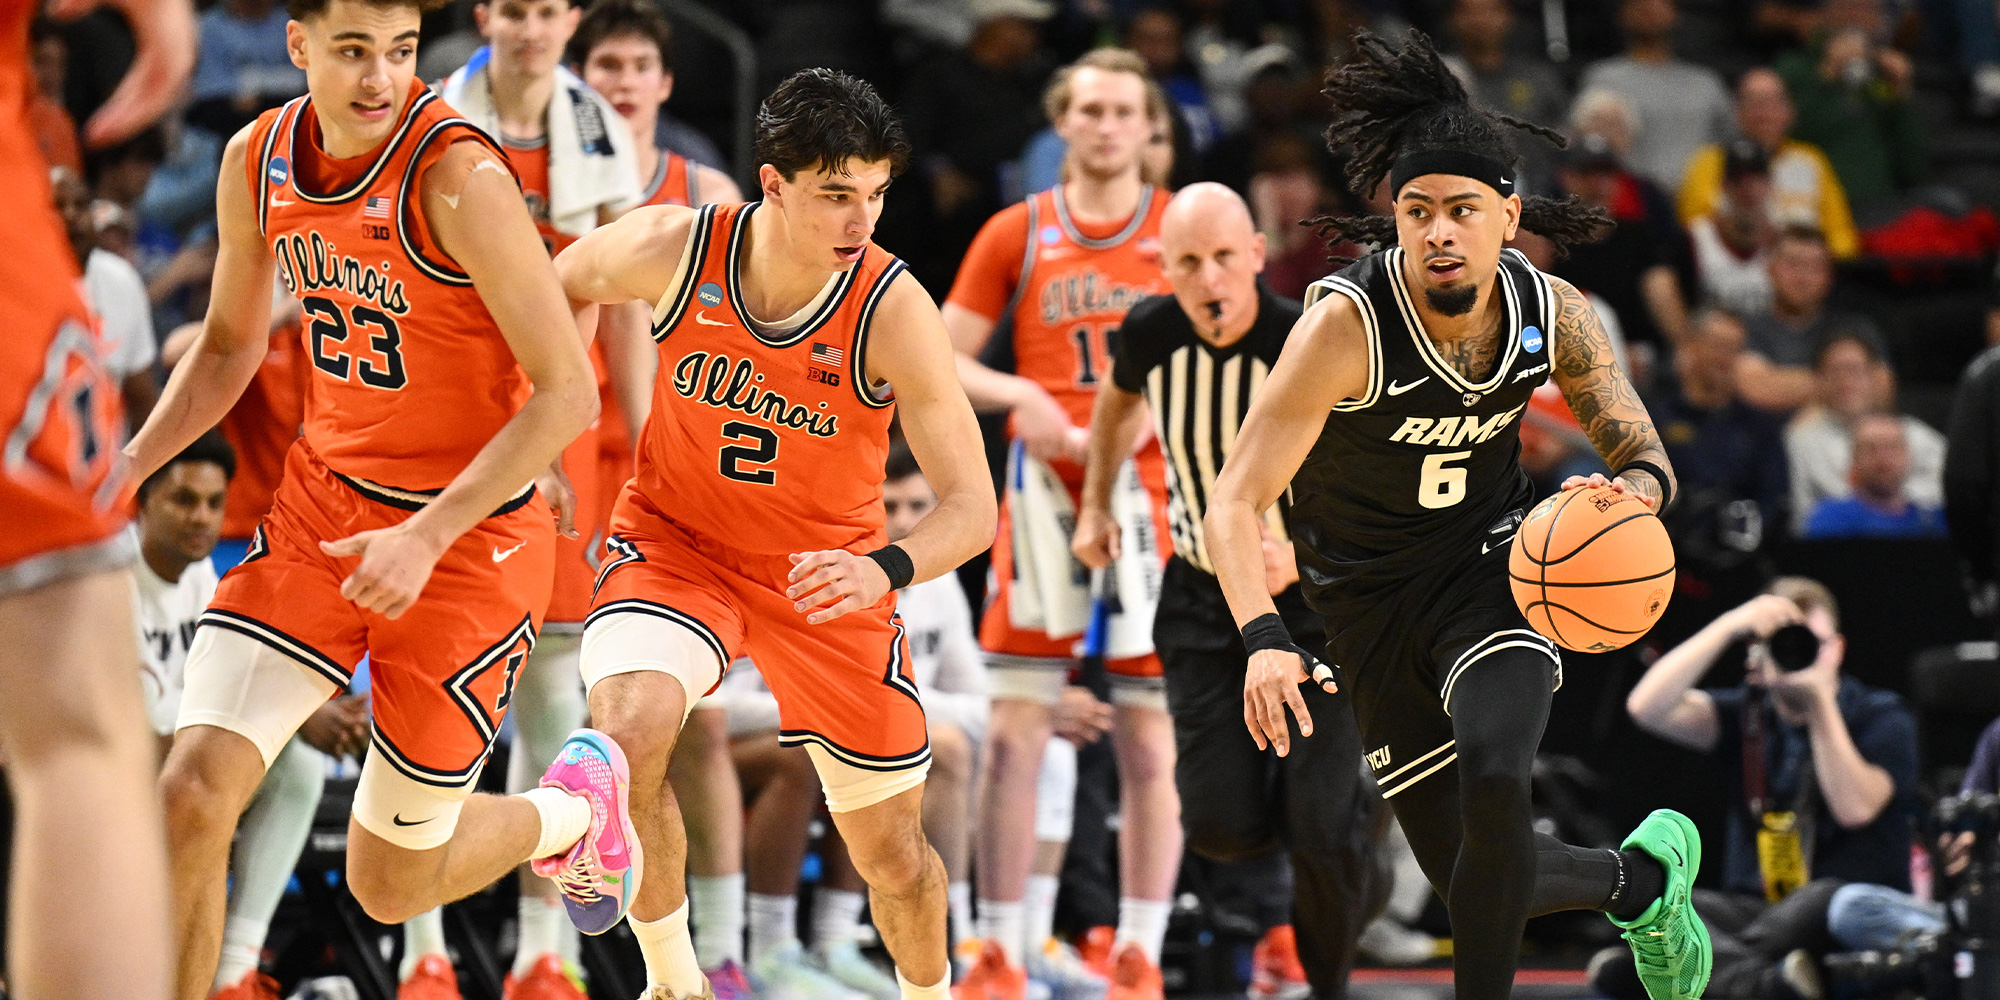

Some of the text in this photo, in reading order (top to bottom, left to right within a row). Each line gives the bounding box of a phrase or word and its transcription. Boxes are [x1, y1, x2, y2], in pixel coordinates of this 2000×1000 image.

[274, 230, 411, 316] Illinois
[699, 291, 721, 305] NCAA
[1042, 270, 1148, 323] Illin
[302, 295, 409, 392] 23
[1524, 336, 1543, 348] NCAA
[671, 350, 840, 437] Illinois
[718, 419, 780, 486] 2
[1388, 401, 1527, 447] RAMS
[1418, 450, 1472, 510] 6
